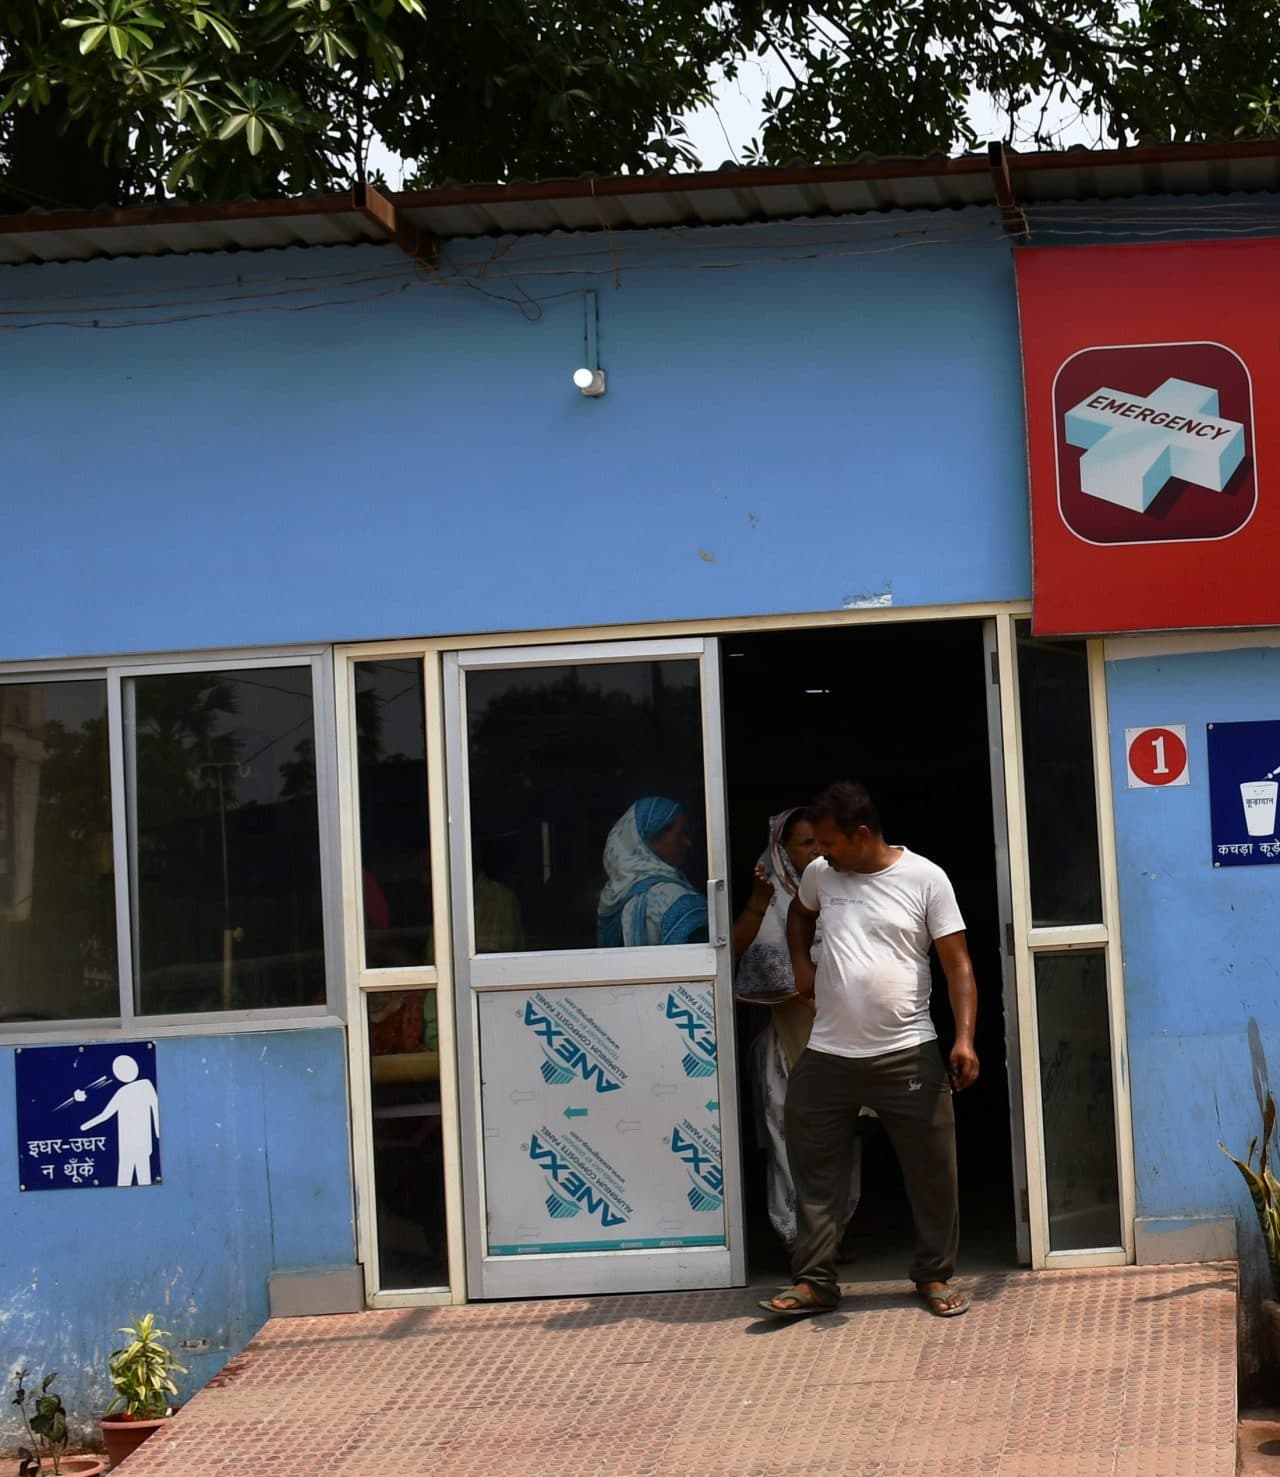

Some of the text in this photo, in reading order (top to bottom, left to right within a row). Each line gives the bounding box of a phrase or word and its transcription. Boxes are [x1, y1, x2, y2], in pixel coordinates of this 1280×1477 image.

[1086, 394, 1233, 440] EMERGENCY
[1152, 736, 1169, 774] 1
[1246, 797, 1274, 808] कूड़ादान
[1216, 842, 1253, 856] कचड़ा
[524, 1000, 622, 1093] ANEXA
[534, 991, 628, 1080] ALUMINIUM COMPOSITE PANEL
[666, 992, 718, 1062] EXA
[28, 1136, 106, 1158] इधर-उधर
[41, 1157, 94, 1183] न थूँकें
[540, 1124, 634, 1214] ALUMINIUM COMPOSITE PANEL
[671, 1126, 724, 1196] EXA
[530, 1134, 628, 1227] ANEXA
